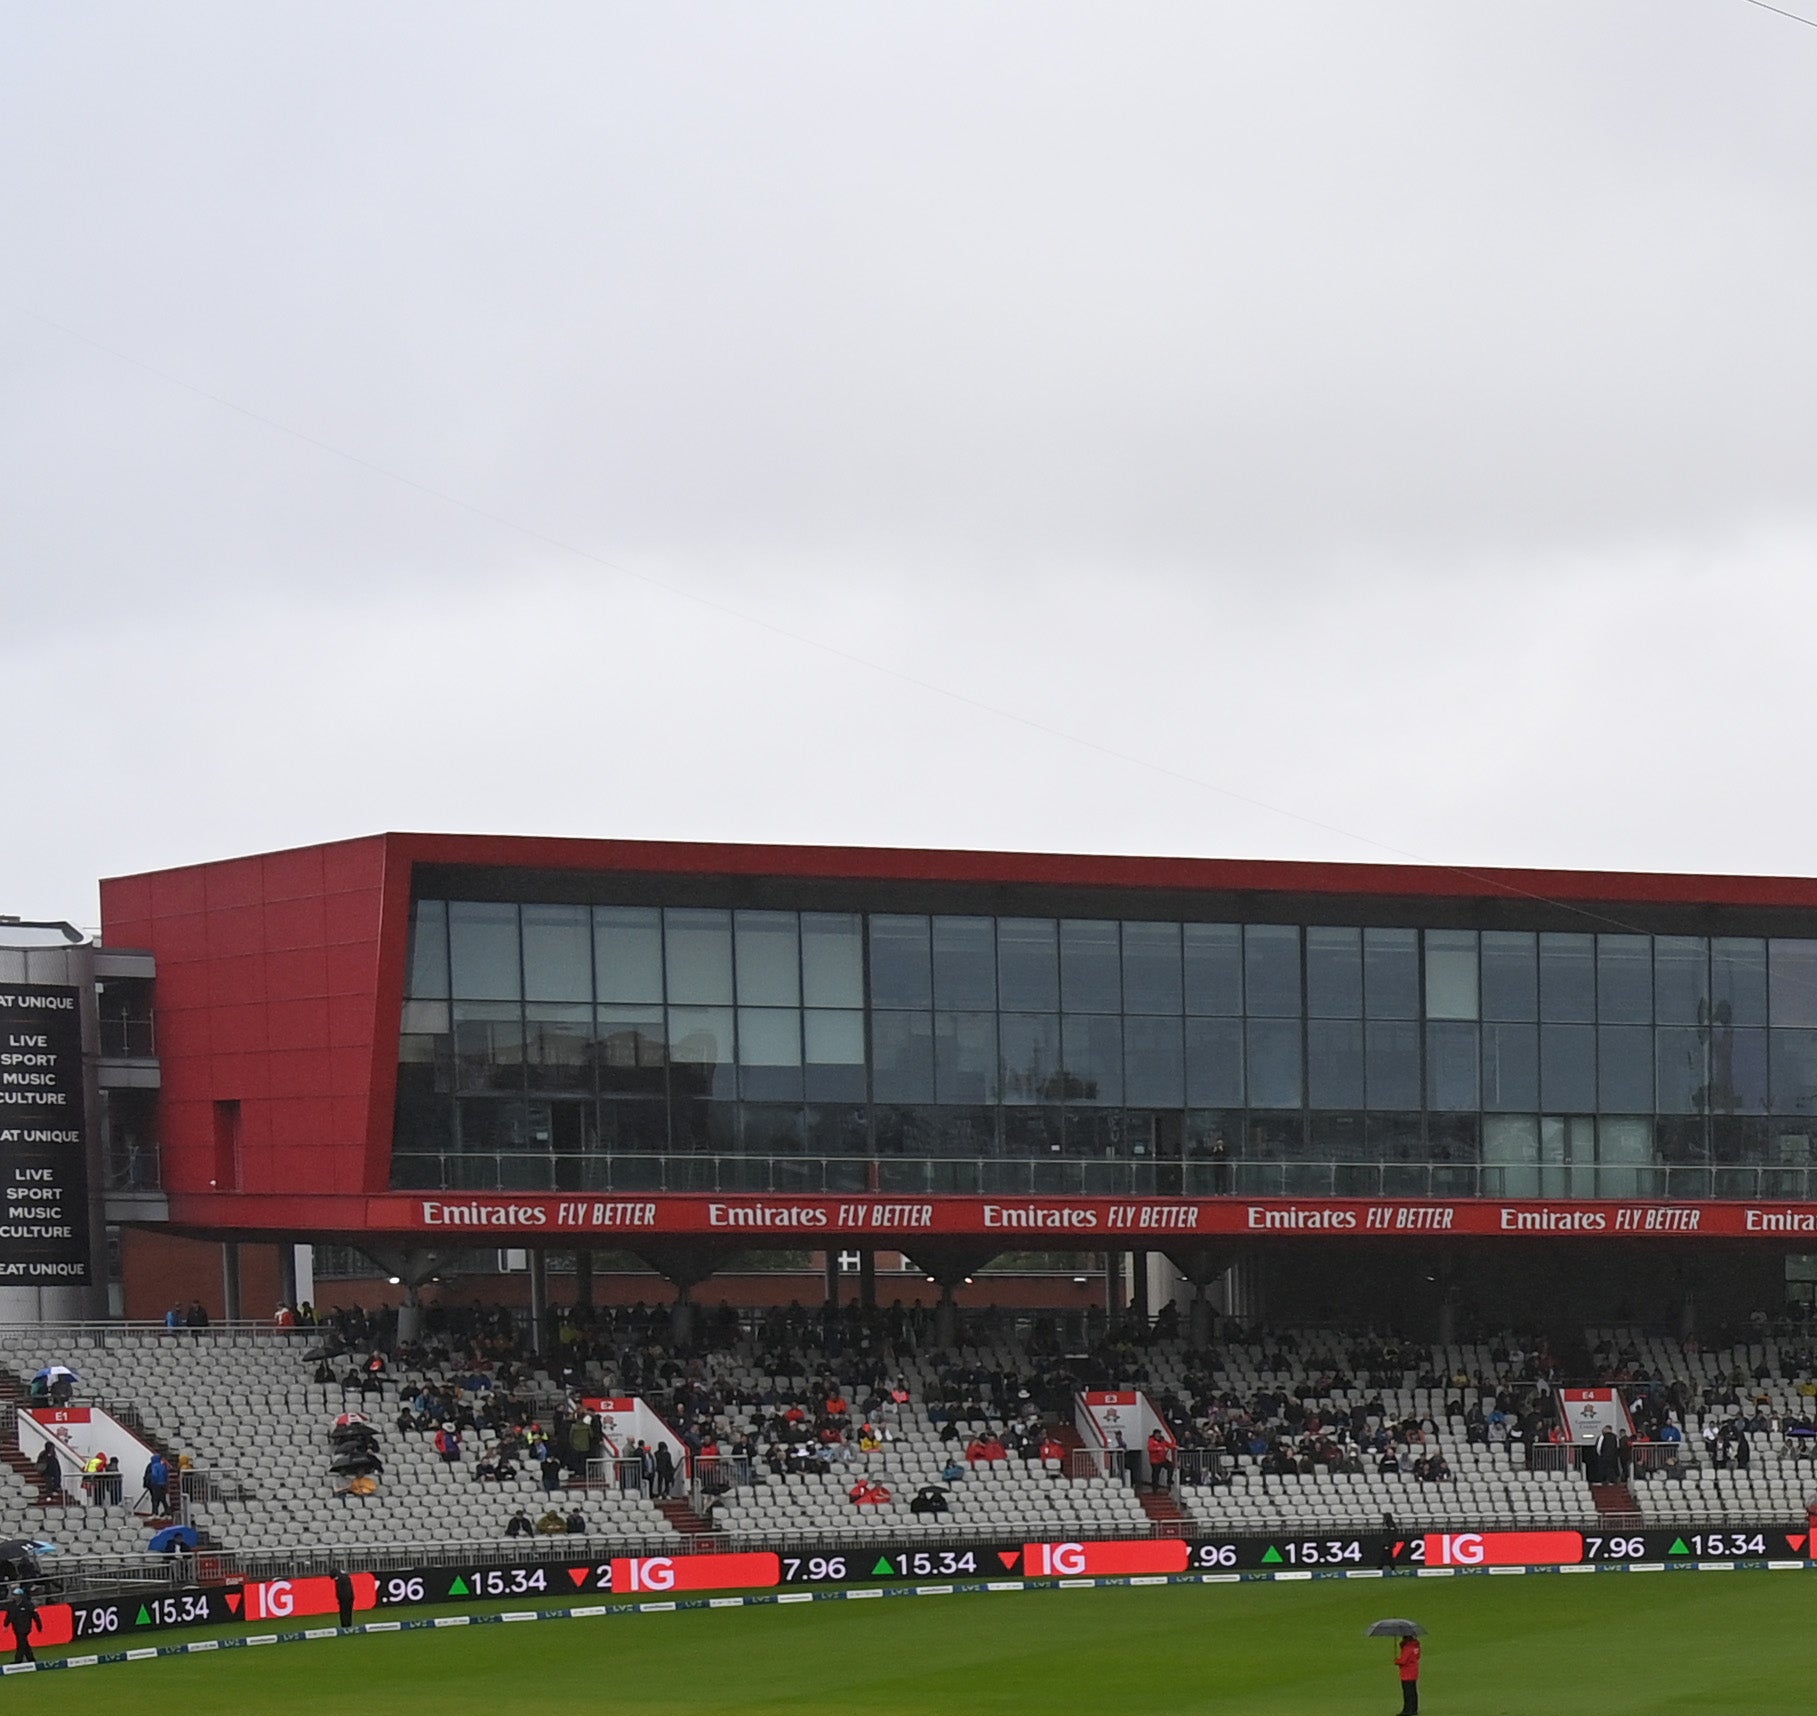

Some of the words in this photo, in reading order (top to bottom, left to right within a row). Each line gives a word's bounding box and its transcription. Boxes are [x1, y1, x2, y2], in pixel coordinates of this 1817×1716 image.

[18, 996, 74, 1010] UNIQUE
[9, 1035, 48, 1047] LIVE
[1, 1055, 57, 1067] SPORT
[3, 1074, 56, 1086] MUSIC
[0, 1092, 66, 1105] CULTURE
[24, 1130, 79, 1143] UNIQUE
[16, 1169, 53, 1181] LIVE
[6, 1188, 62, 1200] SPORT
[9, 1207, 62, 1219] MUSIC
[422, 1202, 546, 1225] Emirates
[558, 1204, 588, 1225] FLY
[592, 1204, 656, 1225] BETTER
[708, 1204, 828, 1226] Emirates
[838, 1205, 867, 1226] FLY
[871, 1206, 932, 1226] BETTER
[984, 1205, 1098, 1228] Emirates
[1107, 1207, 1136, 1228] FLY
[1139, 1207, 1198, 1228] BETTER
[1248, 1206, 1356, 1228] Emirates
[1366, 1208, 1393, 1229] FLY
[1396, 1208, 1454, 1229] BETTER
[1501, 1208, 1606, 1230] Emirates
[1615, 1209, 1642, 1230] FLY
[1644, 1209, 1700, 1230] BETTER
[0, 1226, 72, 1238] CULTURE
[29, 1264, 84, 1277] UNIQUE
[1582, 1391, 1595, 1400] E4
[55, 1412, 68, 1422] E1
[1284, 1540, 1362, 1564] 15.34
[1442, 1532, 1484, 1564] IG
[1586, 1537, 1645, 1559] 7.96
[1691, 1534, 1766, 1556] 15.34
[782, 1556, 846, 1582] 7.96
[896, 1552, 976, 1576] 15.34
[1042, 1542, 1086, 1576] IG
[470, 1568, 548, 1596] 15.34
[630, 1557, 675, 1592] IG
[258, 1580, 294, 1618] IG
[75, 1606, 118, 1636] 7.96
[152, 1595, 210, 1625] 15.34
